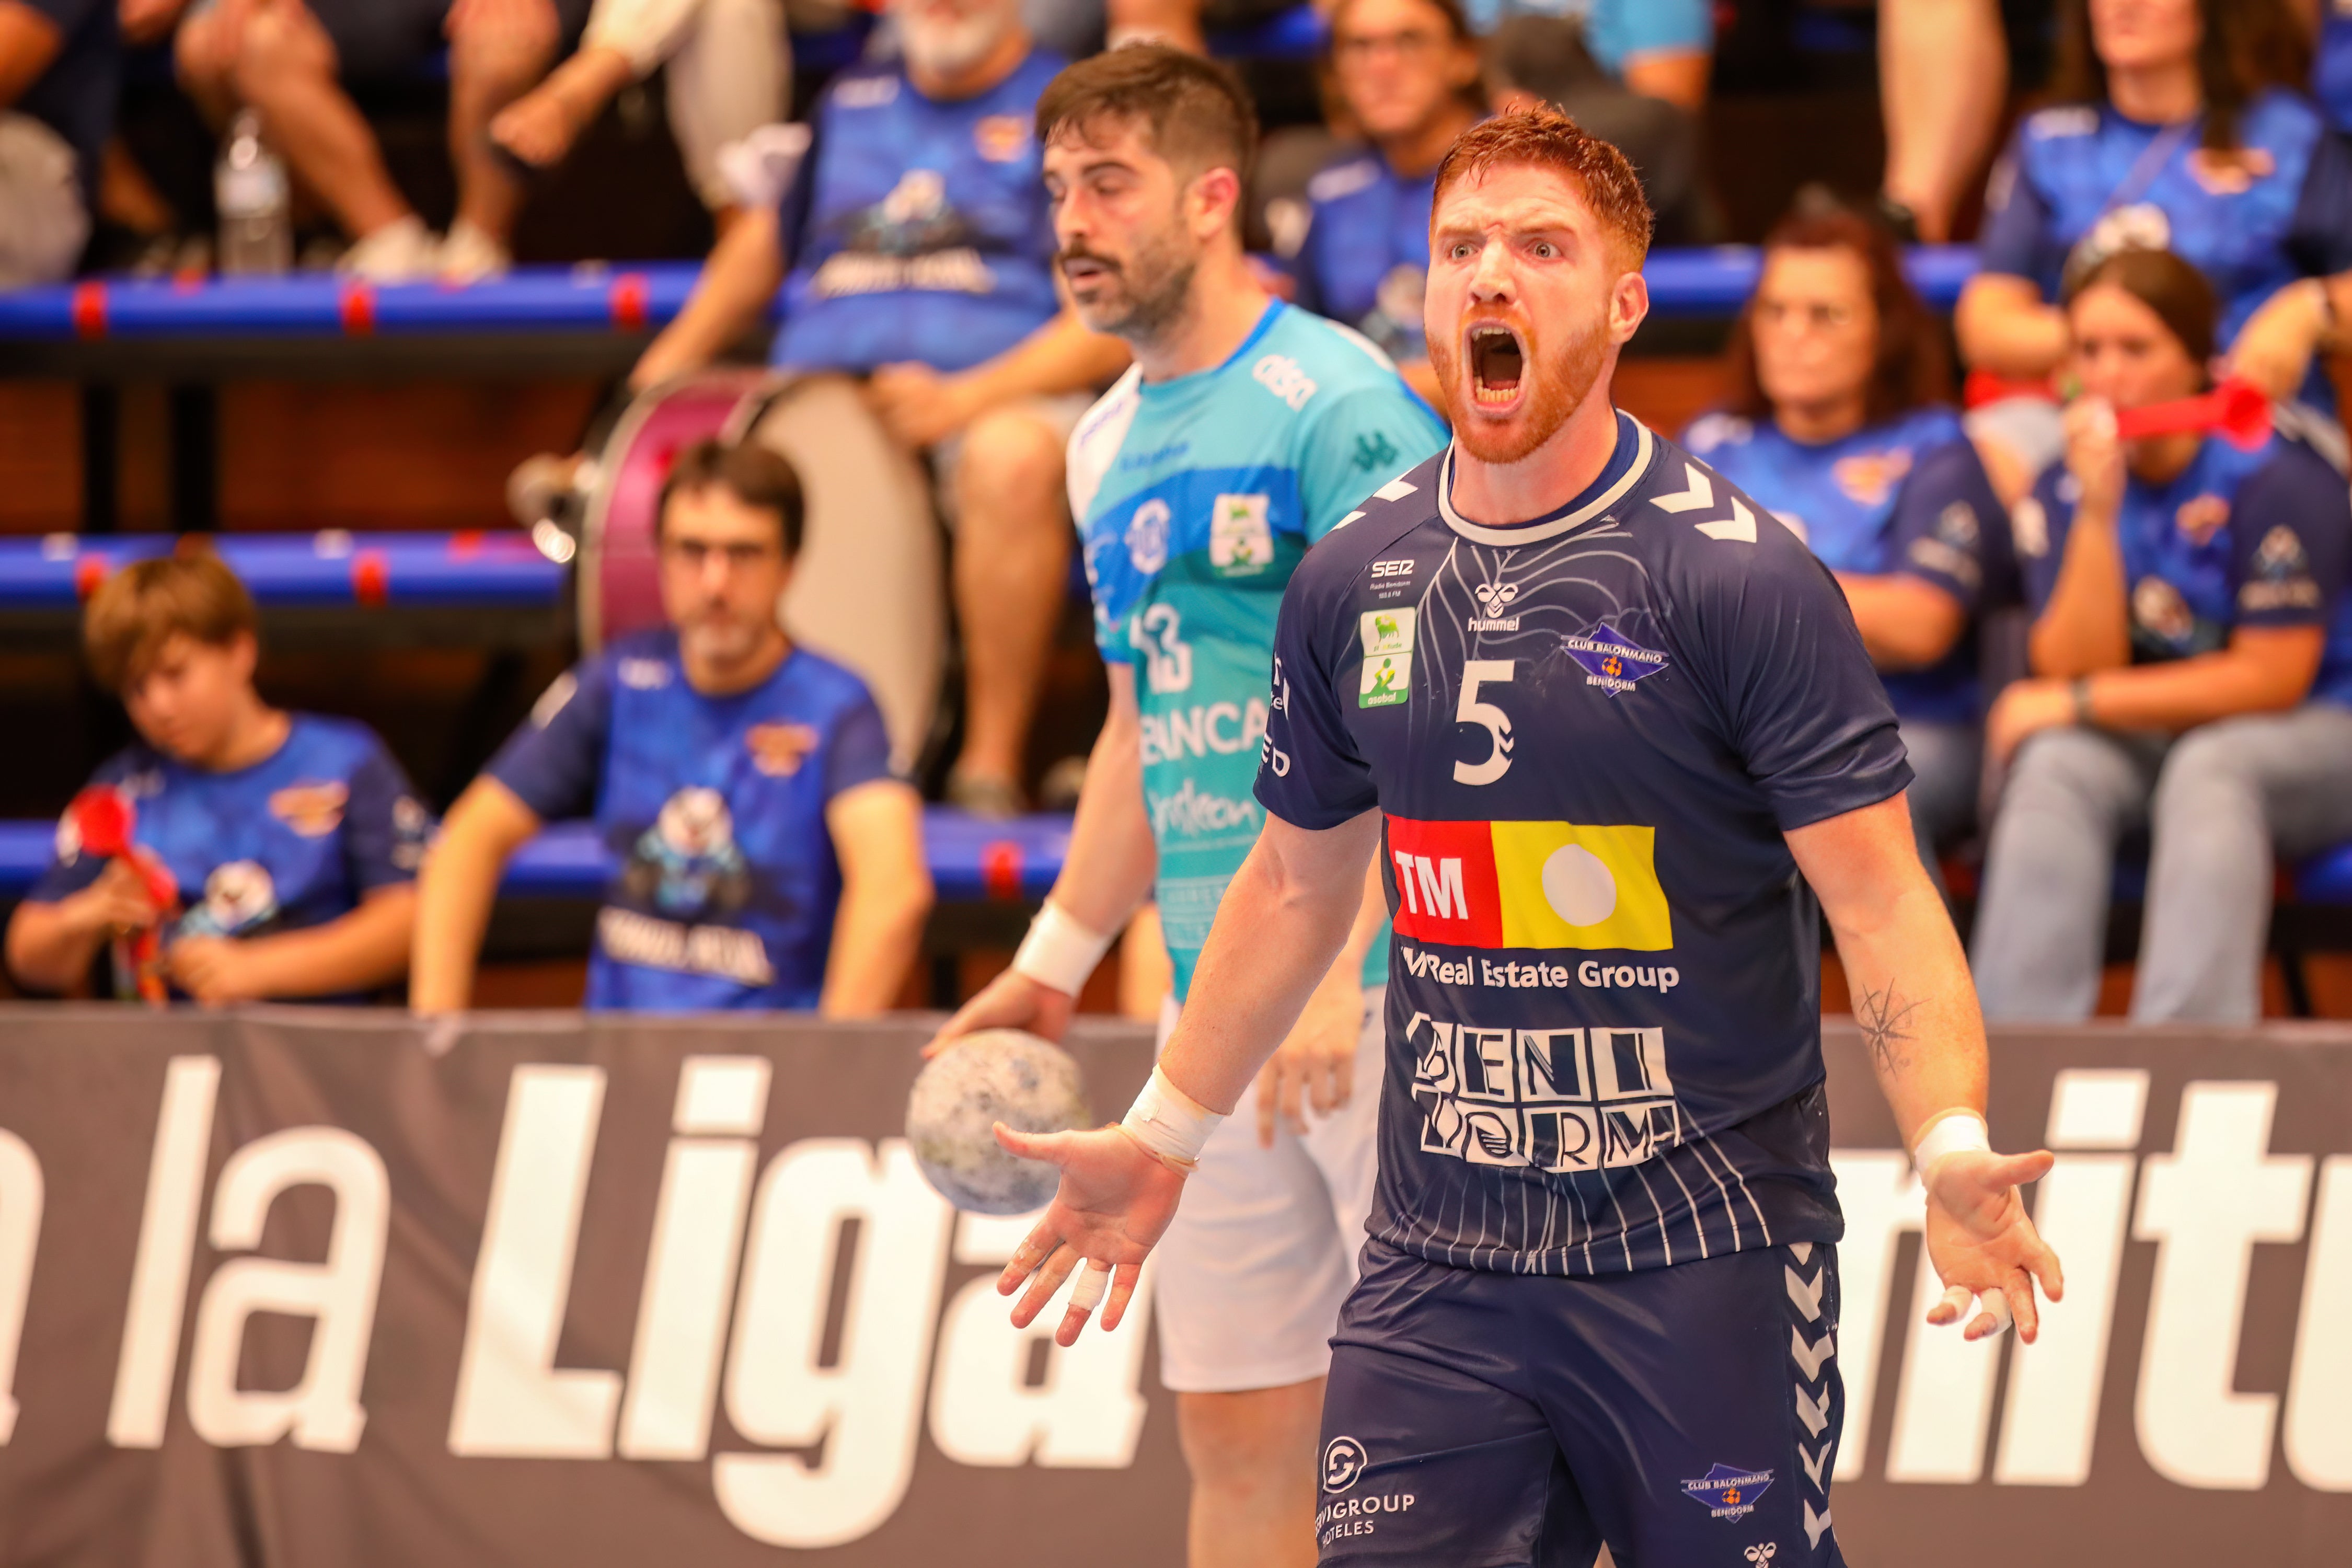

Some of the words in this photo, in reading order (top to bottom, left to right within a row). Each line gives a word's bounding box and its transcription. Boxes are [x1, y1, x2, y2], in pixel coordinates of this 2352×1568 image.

[1371, 559, 1414, 578] SER
[1468, 616, 1520, 632] hummel
[1129, 603, 1193, 695] 13
[1568, 639, 1595, 651] CLUB
[1596, 643, 1663, 663] BALONMANO
[1586, 675, 1636, 691] BENIDORM
[1368, 691, 1397, 705] asobal
[1140, 697, 1267, 765] BANCA
[1453, 660, 1515, 786] 5
[1395, 850, 1469, 920] TM
[1481, 959, 1569, 988] Estate
[1578, 960, 1679, 993] Group
[447, 1054, 1149, 1550] Liga
[1688, 1481, 1711, 1491] CLUB
